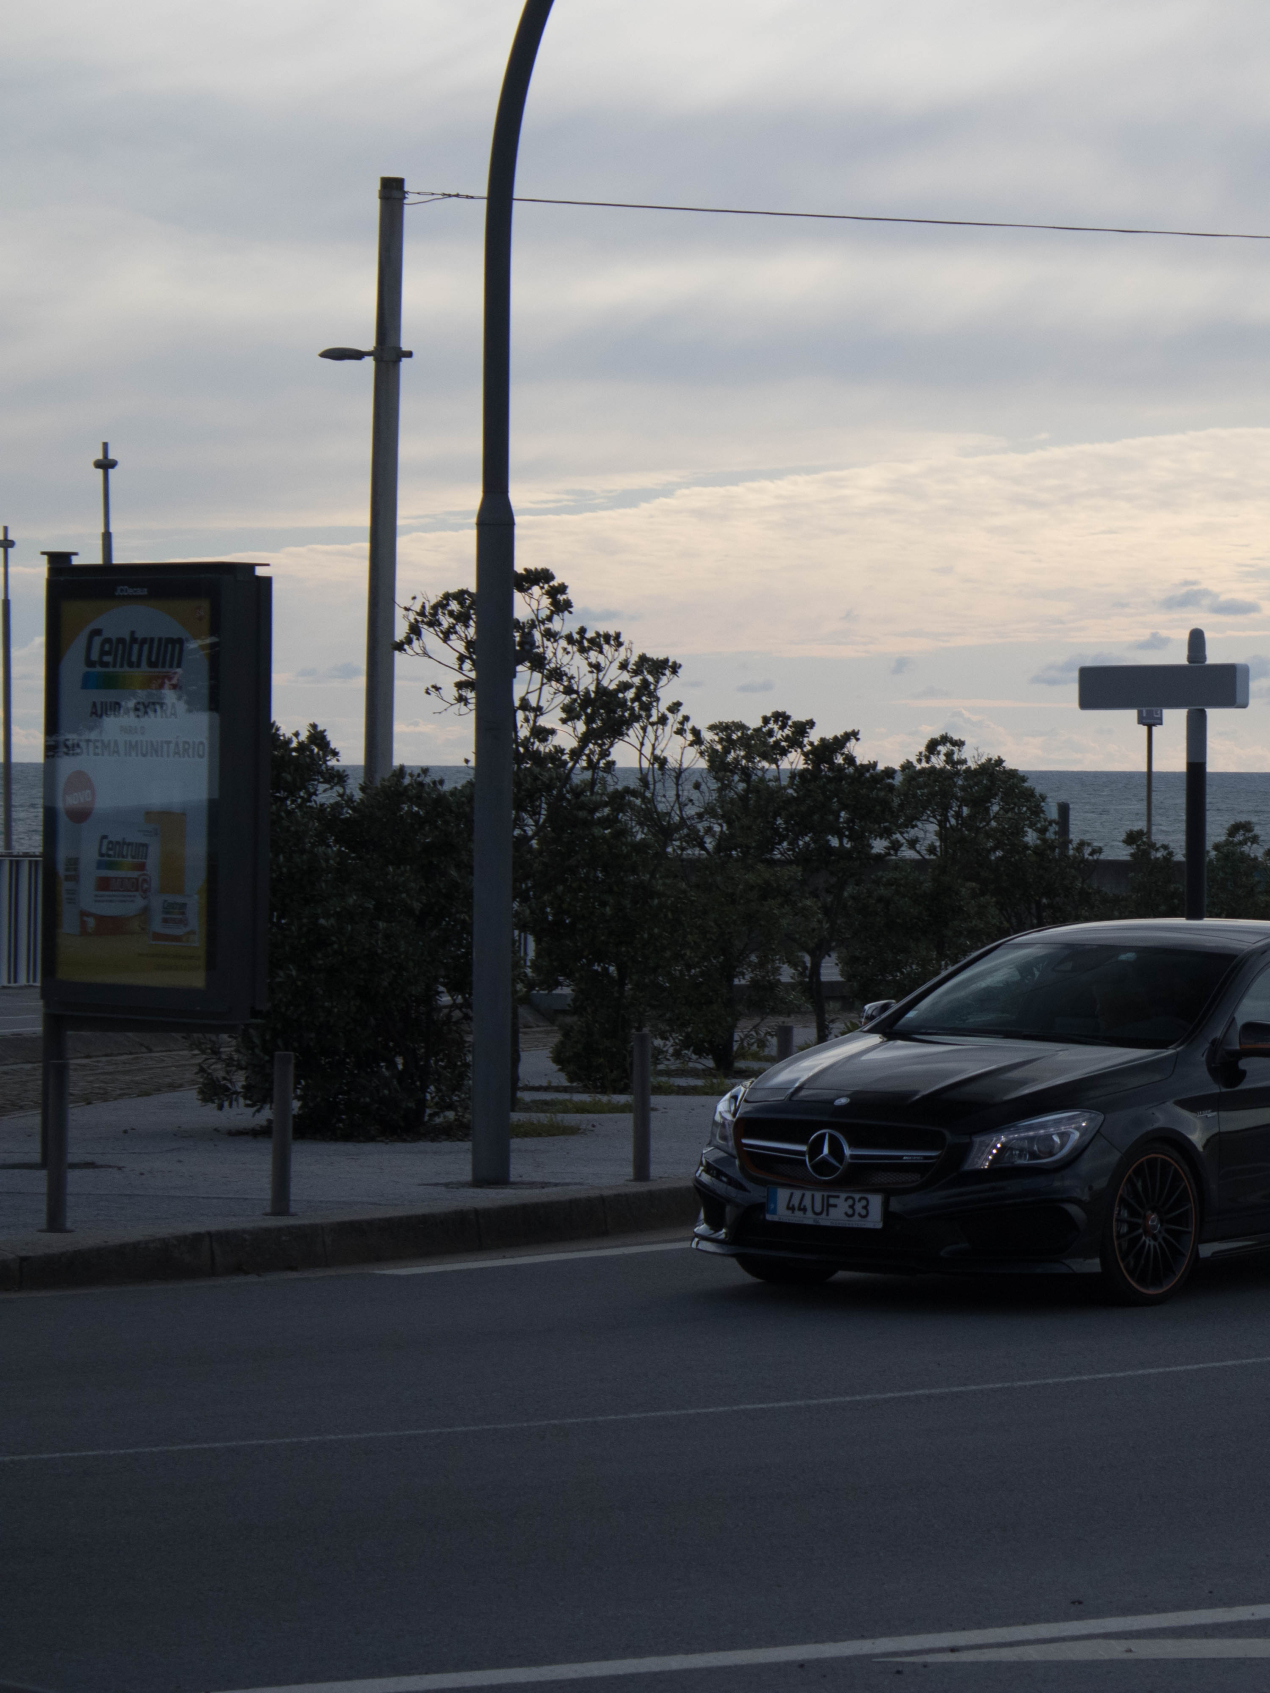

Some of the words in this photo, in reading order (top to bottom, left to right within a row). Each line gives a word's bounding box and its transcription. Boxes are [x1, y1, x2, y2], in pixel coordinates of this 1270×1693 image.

[114, 585, 148, 596] JCDecaux
[84, 628, 185, 669] Centrum
[90, 701, 131, 719] AJUDA
[134, 701, 177, 719] EXTRA
[62, 738, 122, 758] SISTEMA
[123, 736, 206, 759] IMUNITÁRIO
[65, 790, 92, 806] NOVO
[98, 835, 149, 861] Centrum
